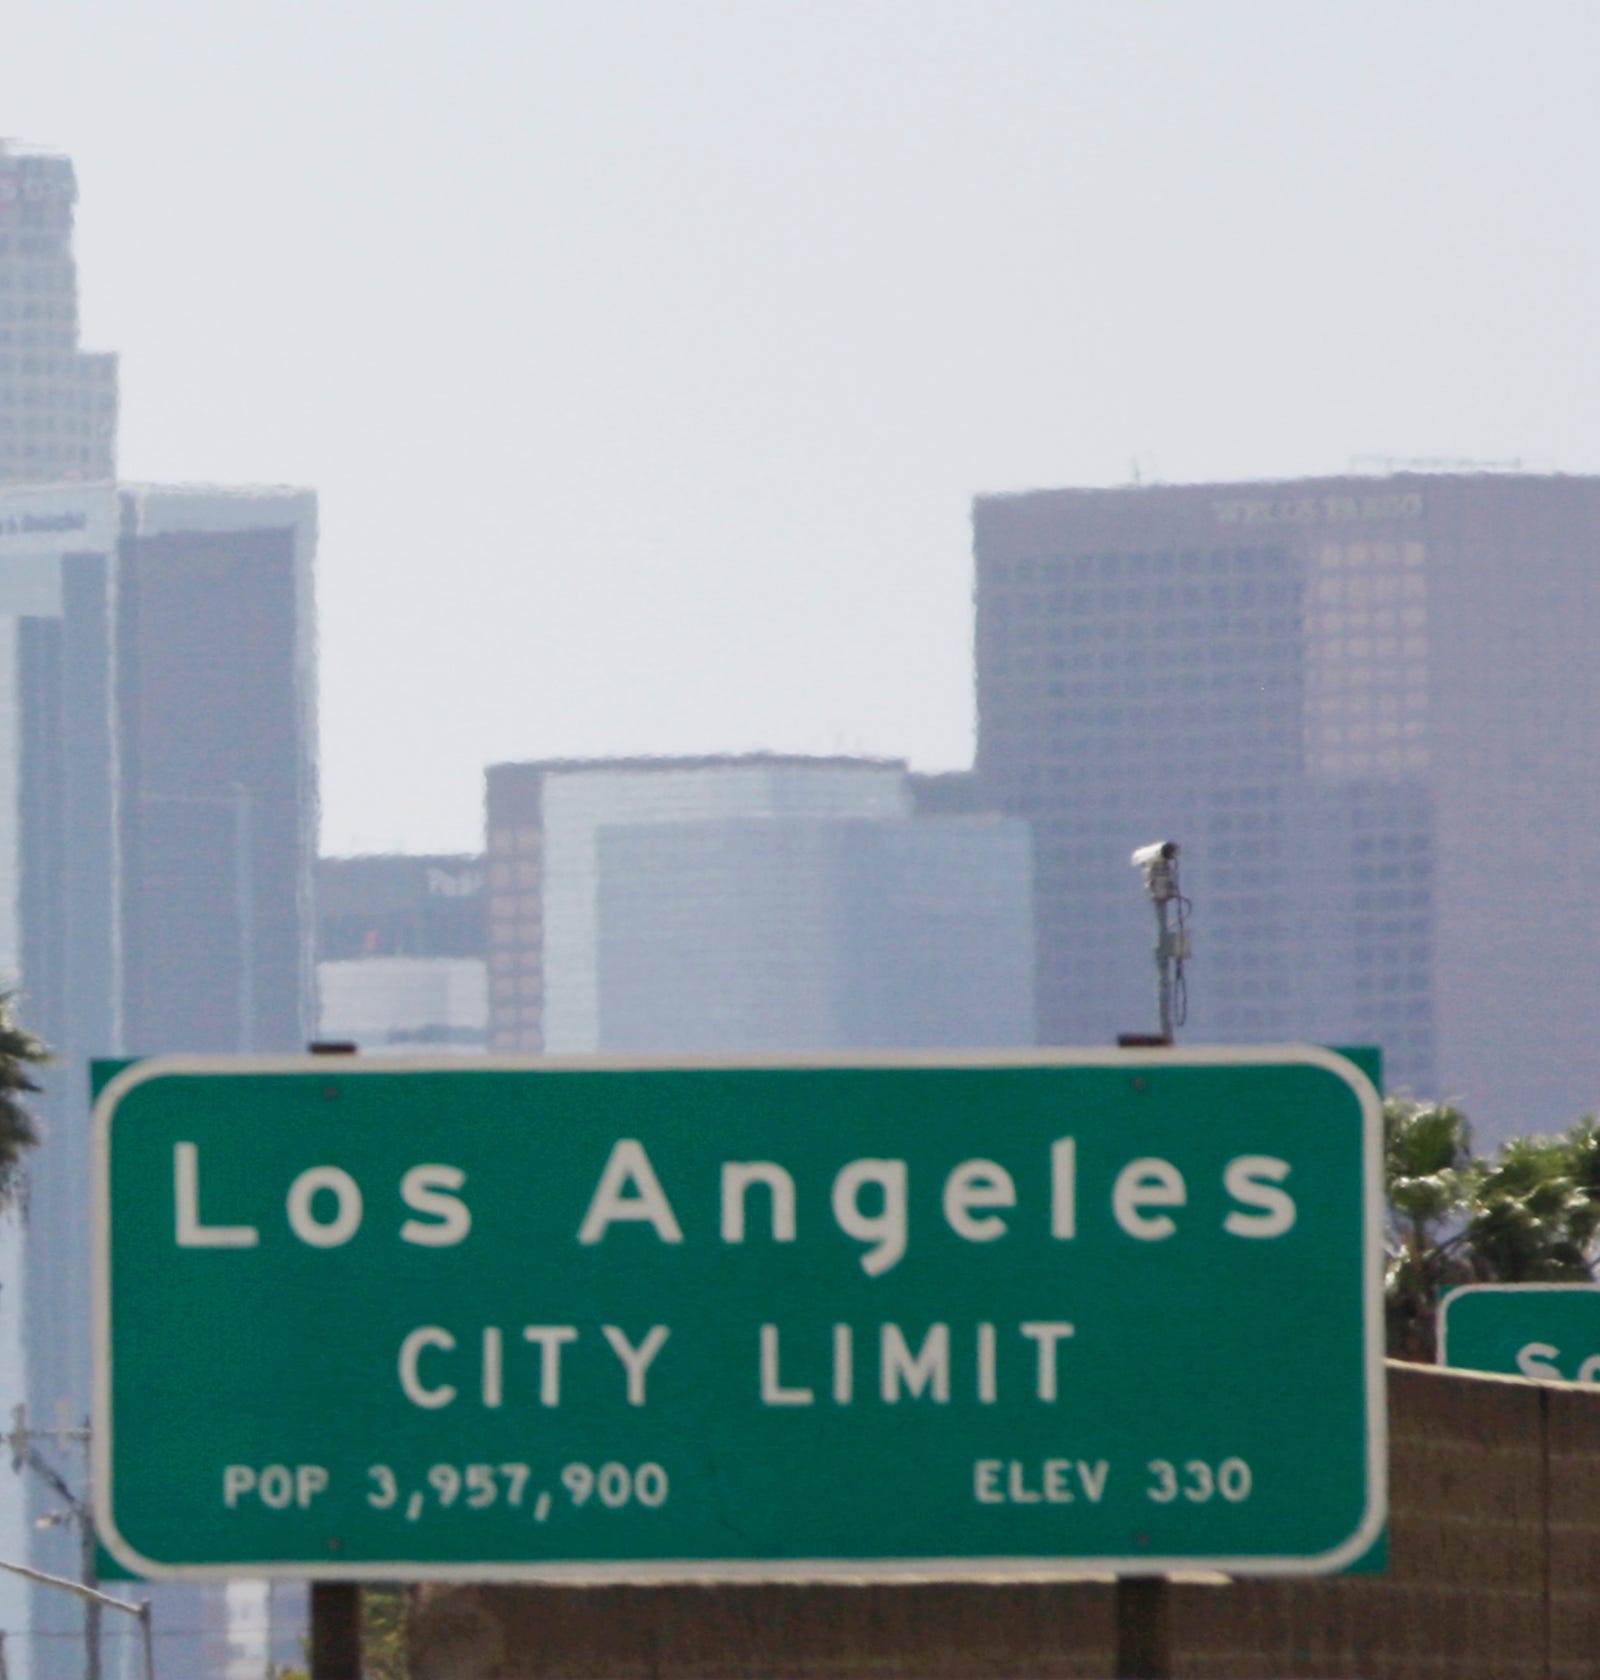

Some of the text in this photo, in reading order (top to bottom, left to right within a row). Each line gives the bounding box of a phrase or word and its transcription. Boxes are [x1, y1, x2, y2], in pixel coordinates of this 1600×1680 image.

[173, 1136, 1298, 1277] Los Angeles
[398, 1322, 1075, 1408] CITY LIMIT
[222, 1461, 669, 1521] POP 3,957,900
[973, 1457, 1254, 1504] ELEV 330
